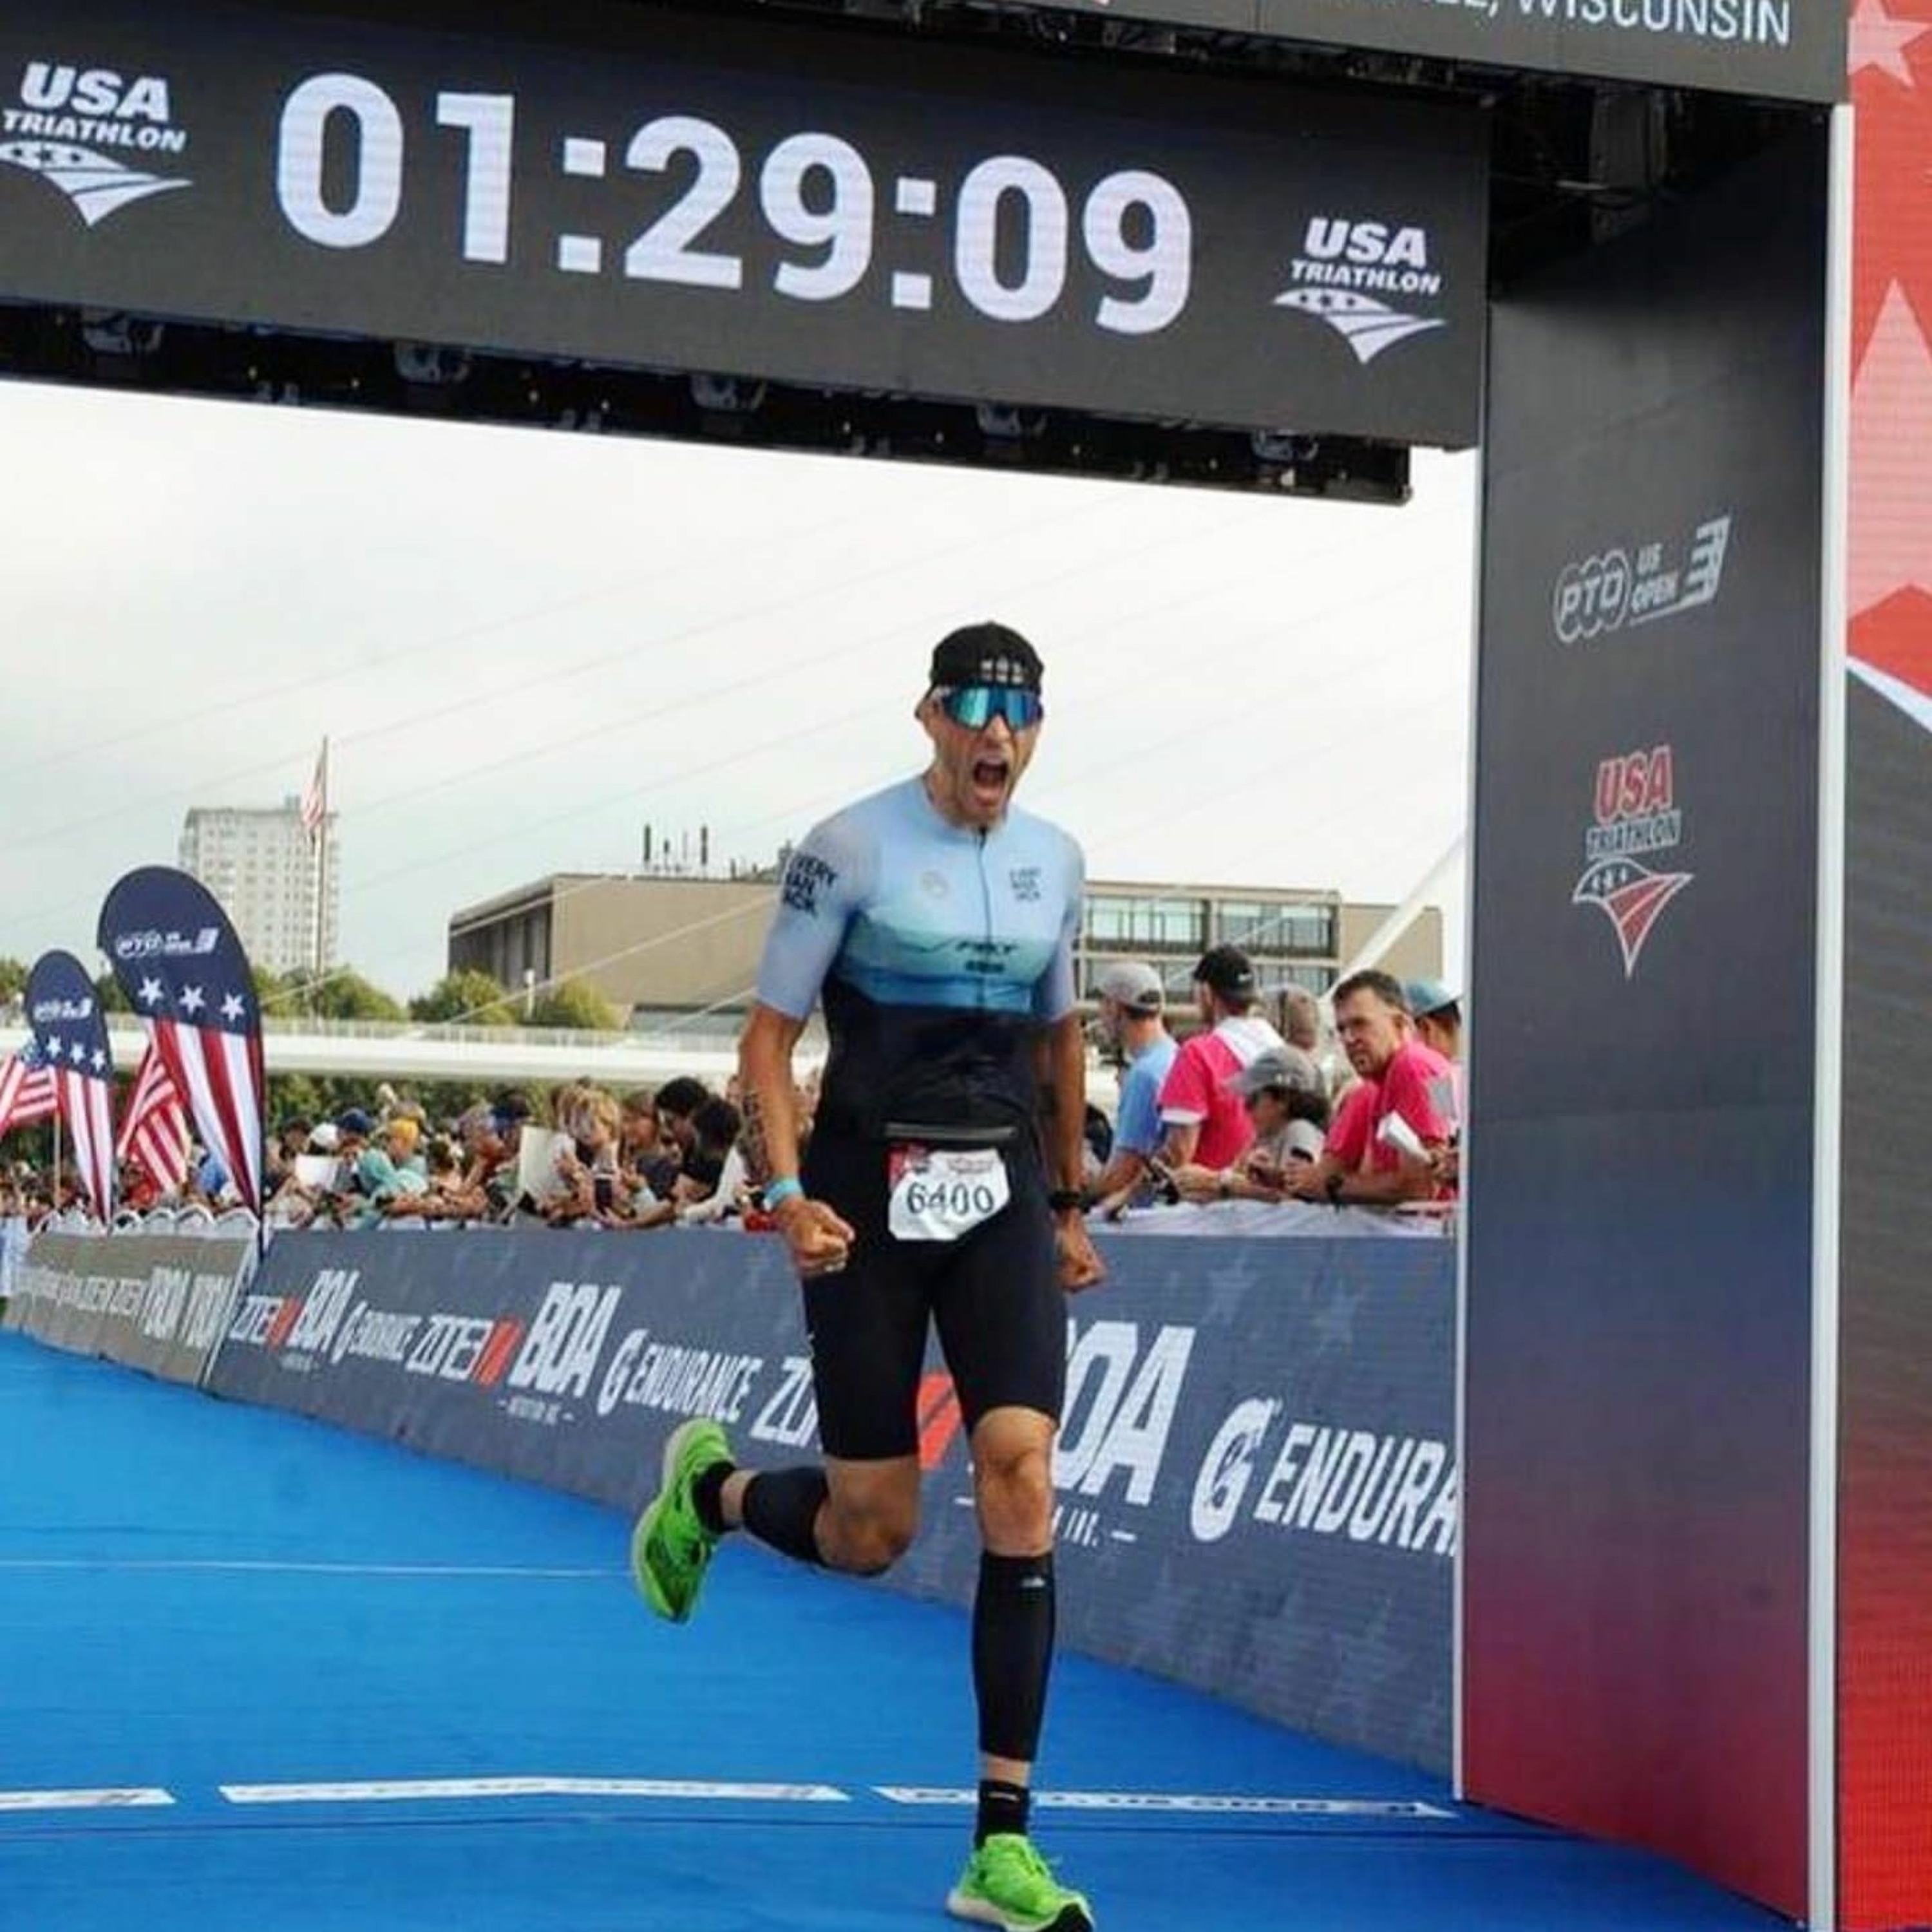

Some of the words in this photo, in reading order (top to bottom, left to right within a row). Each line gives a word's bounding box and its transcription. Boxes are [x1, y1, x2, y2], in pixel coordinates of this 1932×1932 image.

[21, 62, 170, 122] USA
[2, 111, 187, 152] TRIATHLON
[278, 73, 1192, 334] 01:29:09
[1304, 218, 1428, 268] USA
[1290, 261, 1441, 294] TRIATHLON
[1558, 565, 1625, 625] PTO
[1594, 745, 1673, 828] USA
[907, 1182, 994, 1215] 6400
[507, 1282, 621, 1398] BOA
[623, 1343, 763, 1424] ENDURANCE
[1050, 1317, 1196, 1506] OA
